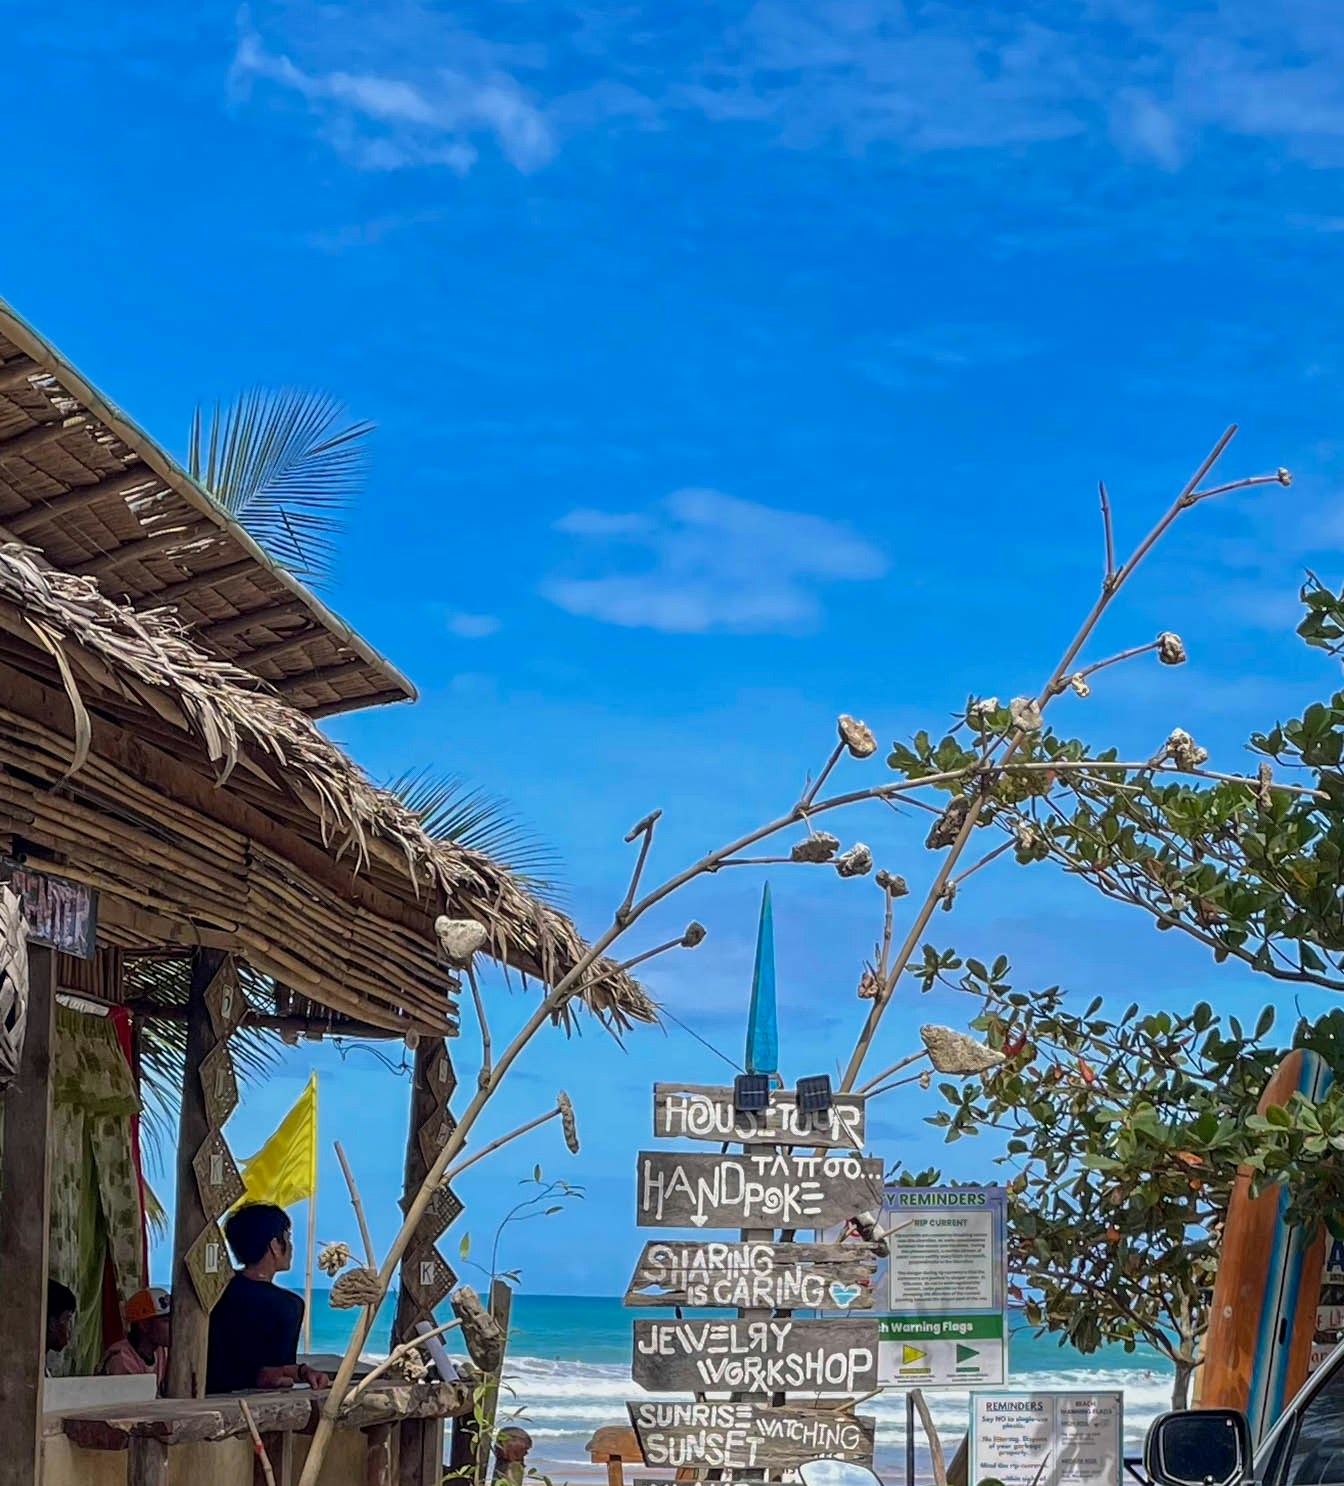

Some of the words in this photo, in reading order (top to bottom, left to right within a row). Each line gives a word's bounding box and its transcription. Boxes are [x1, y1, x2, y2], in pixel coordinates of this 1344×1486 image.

[899, 1193, 986, 1206] REMINDERS
[643, 1244, 775, 1289] SHARING
[687, 1283, 708, 1306] IS
[713, 1266, 825, 1308] CARING
[891, 1320, 941, 1335] Warning
[942, 1320, 974, 1335] Flags
[697, 1348, 873, 1393] WORKSHOP
[637, 1404, 753, 1429] SUNRISE
[986, 1401, 1044, 1412] REMINDERS
[647, 1430, 765, 1468] SUNSET
[756, 1417, 861, 1450] WATCHING
